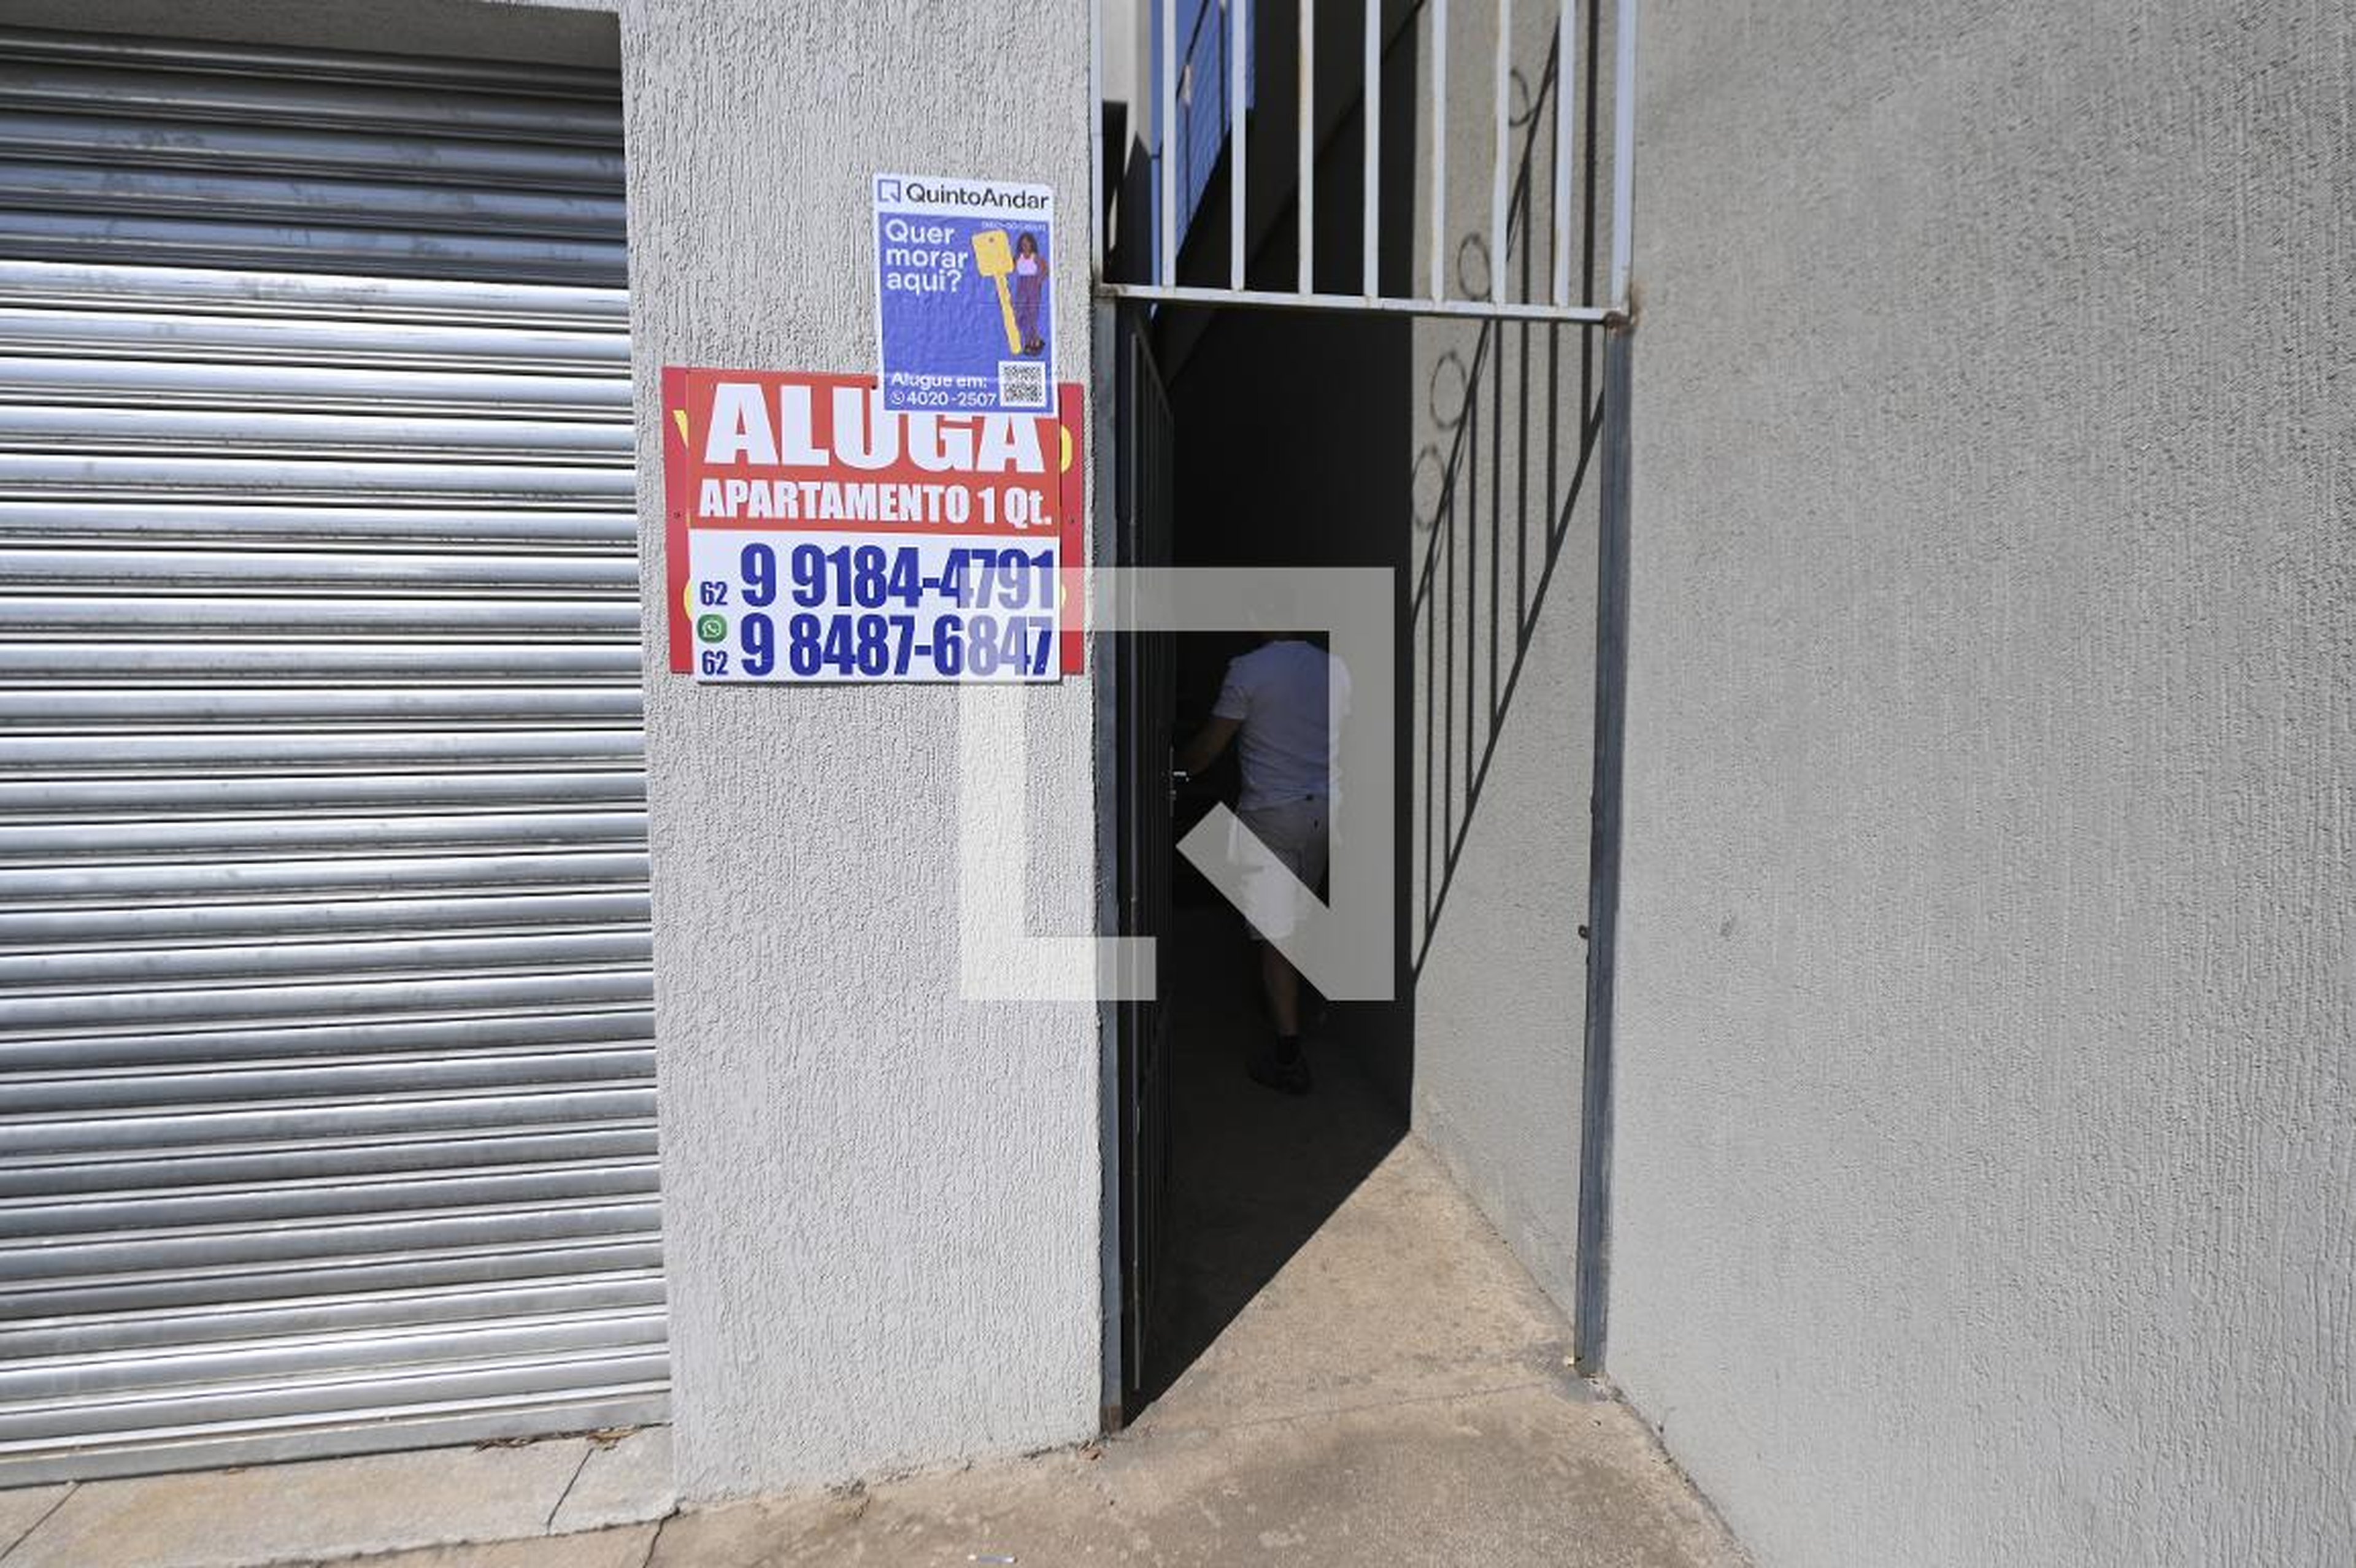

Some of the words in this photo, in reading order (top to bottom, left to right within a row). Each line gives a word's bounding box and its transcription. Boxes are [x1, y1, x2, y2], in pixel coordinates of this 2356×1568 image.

[907, 183, 1050, 209] QuintoAndar
[885, 218, 955, 244] Quer
[885, 247, 968, 269] morar
[886, 270, 963, 297] aqui?
[891, 372, 952, 391] Alugue
[956, 375, 987, 388] em:
[704, 382, 1045, 472] ALUGA
[699, 478, 969, 524] APARTAMENTO
[977, 486, 995, 524] 1
[1004, 487, 1052, 529] Qt.
[699, 581, 728, 607] 62
[740, 542, 776, 608] 9
[791, 544, 1054, 609] 9184-4791
[701, 650, 728, 675] 62
[740, 612, 775, 675] 9
[789, 613, 1053, 676] 8487-6847
